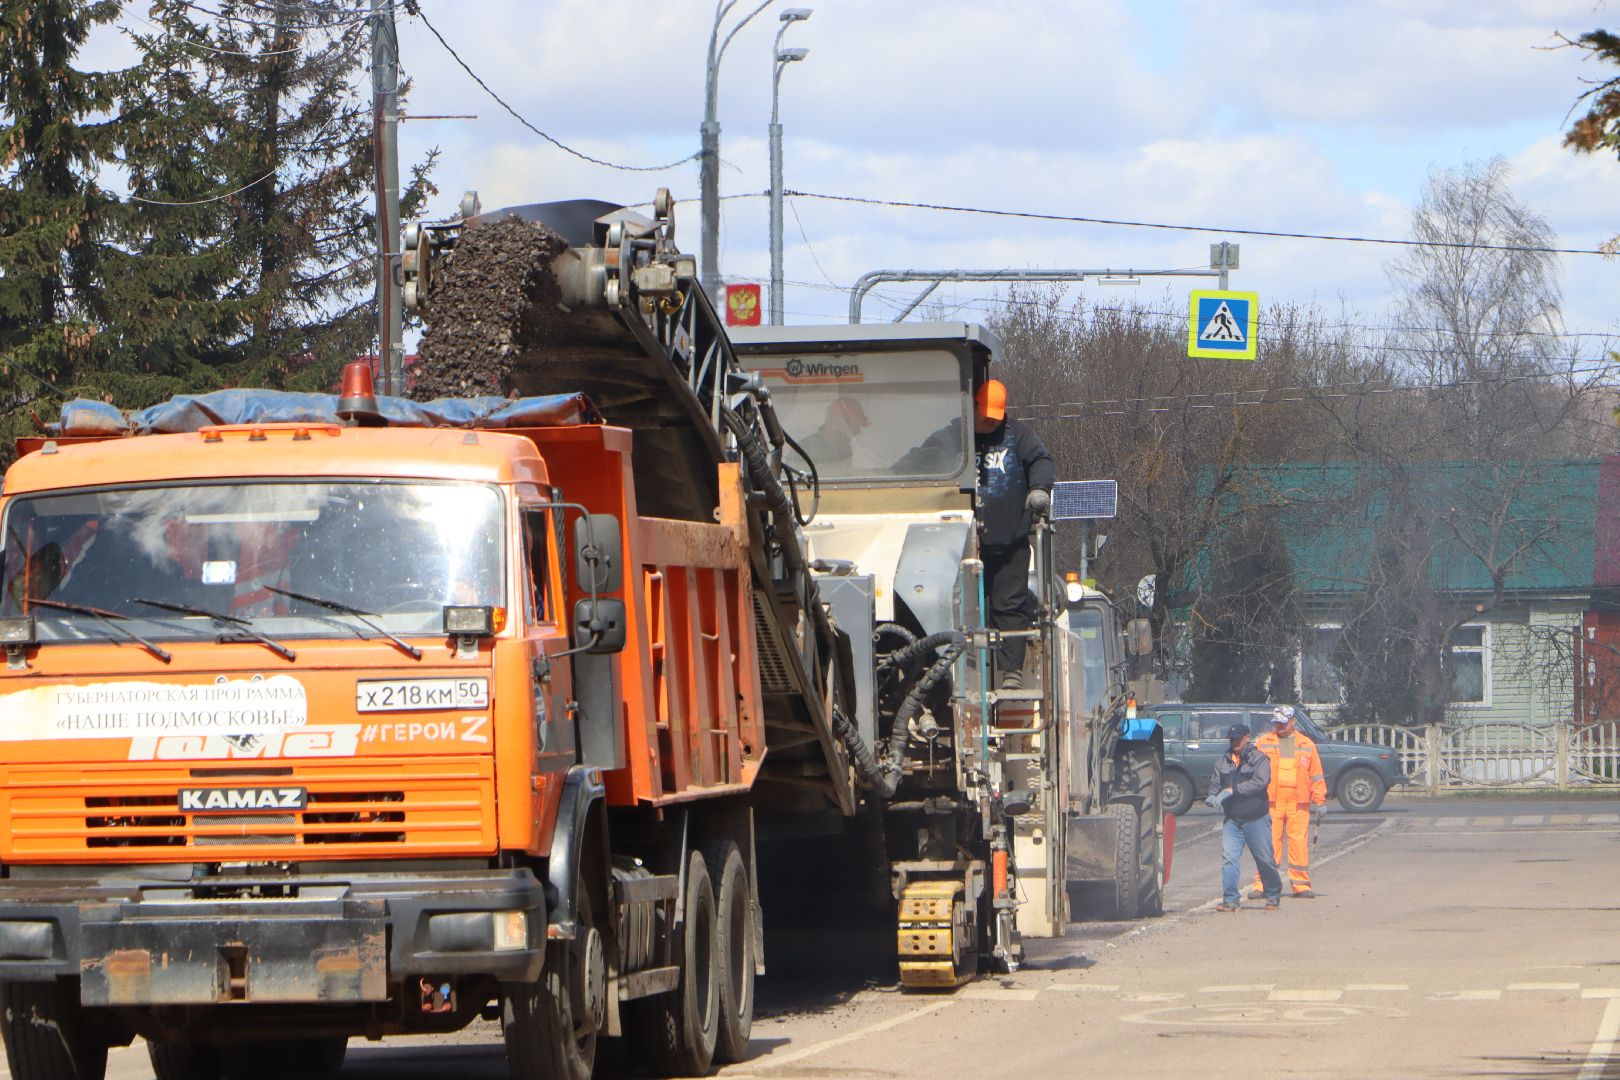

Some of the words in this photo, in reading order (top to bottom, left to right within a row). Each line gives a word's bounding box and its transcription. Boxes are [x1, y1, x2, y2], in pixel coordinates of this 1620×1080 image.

[806, 363, 859, 377] Wirtgen
[57, 688, 199, 705] ГУБЕРНАТОРСКАЯ
[203, 686, 305, 703] ПРОГРАММА
[459, 682, 479, 697] 50
[56, 711, 130, 731] «НАШЕ
[136, 709, 306, 730] ПОДМОСКОВЬЕ»
[182, 788, 302, 809] KAMAZ
